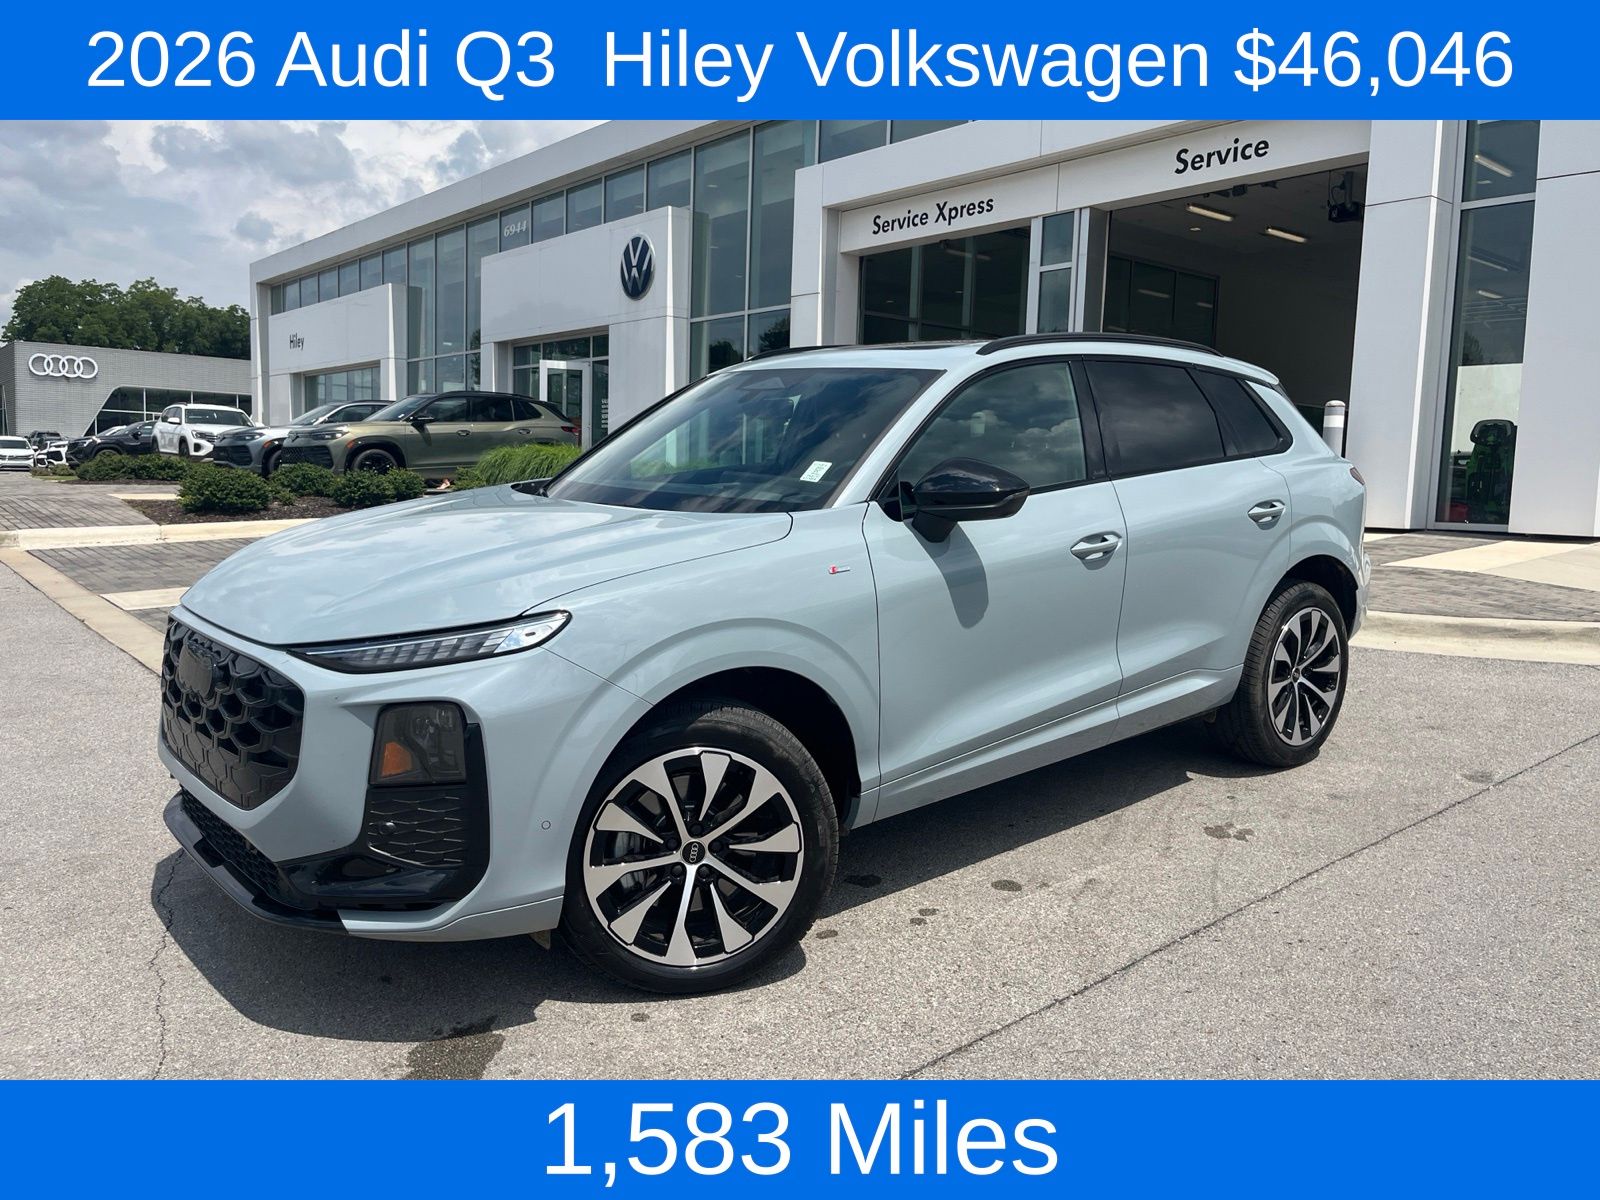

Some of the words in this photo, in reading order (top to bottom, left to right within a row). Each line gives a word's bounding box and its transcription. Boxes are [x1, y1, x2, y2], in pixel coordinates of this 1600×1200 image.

[1174, 137, 1270, 175] Service
[503, 220, 527, 238] 6944
[872, 209, 929, 235] Service
[934, 198, 994, 226] Xpress
[289, 332, 305, 351] Hiley
